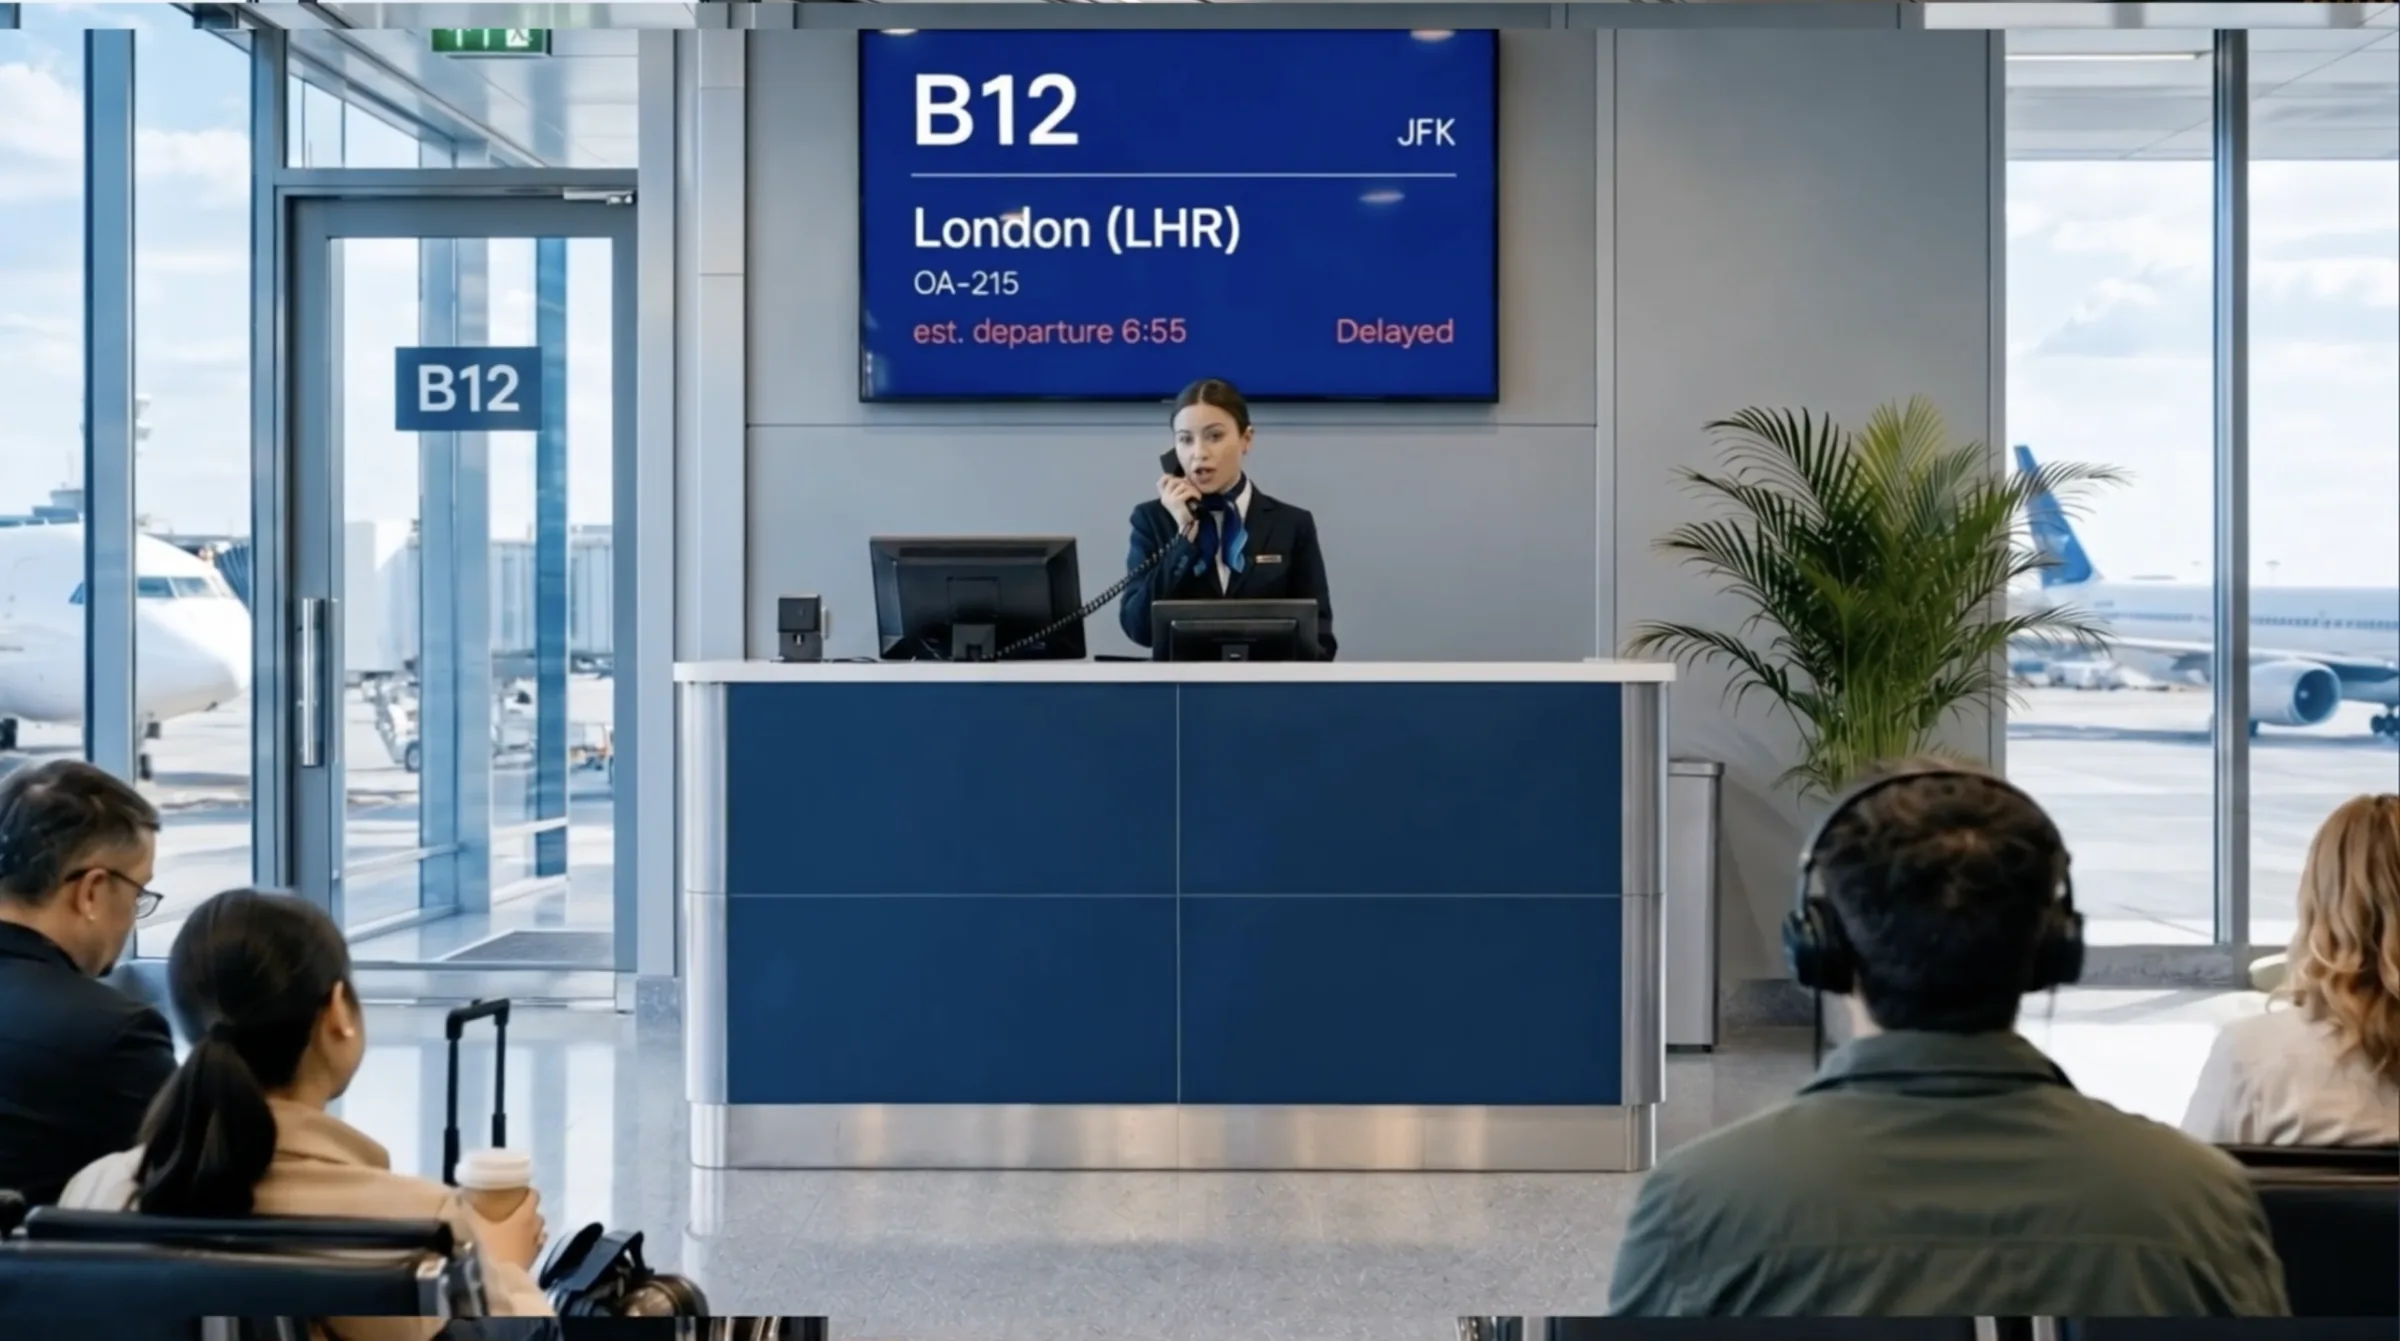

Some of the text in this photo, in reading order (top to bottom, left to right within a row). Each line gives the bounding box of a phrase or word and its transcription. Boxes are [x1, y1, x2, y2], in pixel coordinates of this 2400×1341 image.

[914, 73, 1080, 147] B12
[1396, 118, 1457, 147] JFK
[914, 205, 1241, 255] London (LHR)
[913, 270, 1020, 296] OA-215
[912, 318, 1188, 350] est. departure 6:55
[1336, 317, 1455, 350] Delayed
[417, 364, 521, 413] B12
